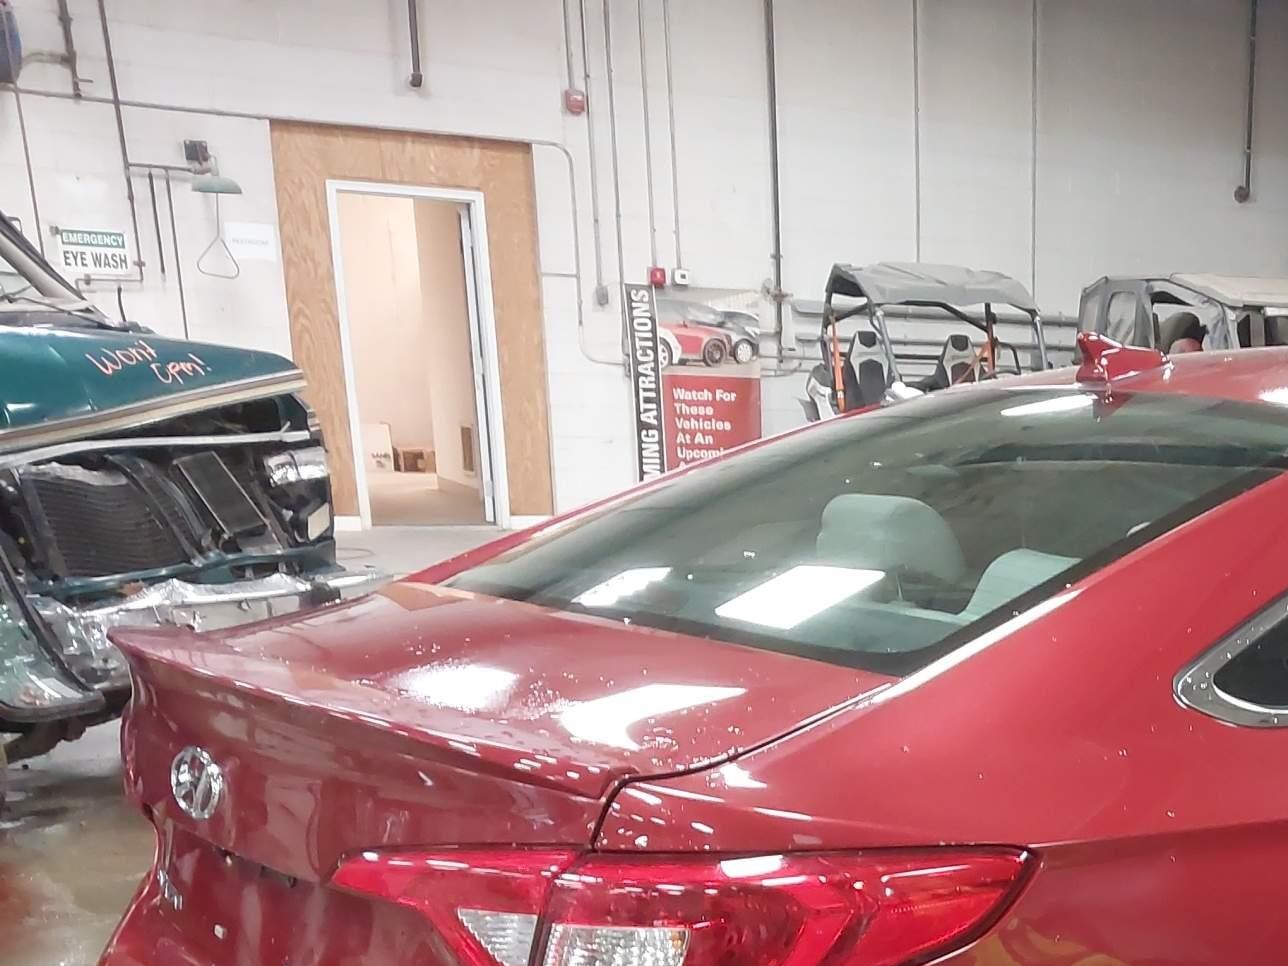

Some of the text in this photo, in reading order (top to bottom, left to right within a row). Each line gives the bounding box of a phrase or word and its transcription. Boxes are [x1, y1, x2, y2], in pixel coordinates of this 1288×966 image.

[62, 231, 124, 247] EMERGENCY
[63, 250, 129, 270] EYE WASH
[630, 288, 658, 425] ATTRACTIONS
[672, 387, 737, 402] Watch For
[674, 402, 714, 416] These
[675, 417, 732, 431] Vehicles
[676, 431, 714, 445] At An
